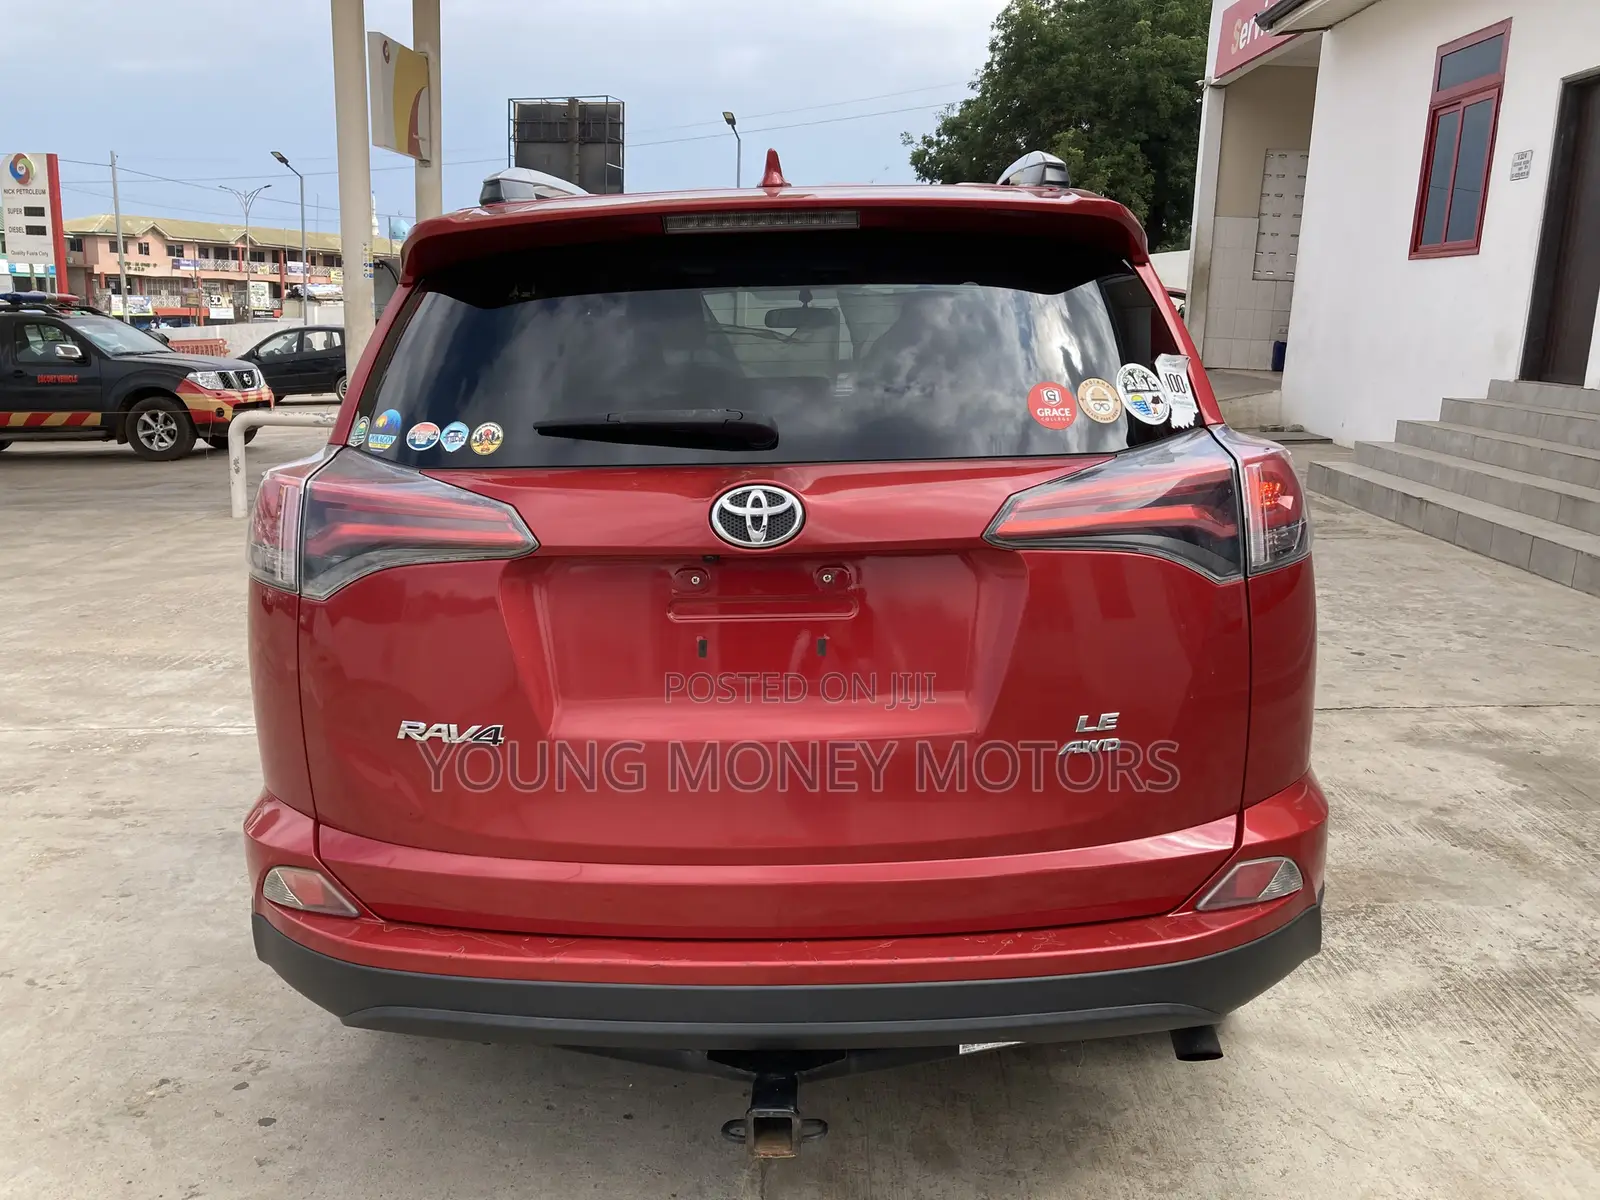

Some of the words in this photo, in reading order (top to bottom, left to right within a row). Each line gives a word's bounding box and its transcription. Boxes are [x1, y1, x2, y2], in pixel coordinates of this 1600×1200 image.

[1164, 372, 1187, 394] 100
[1036, 407, 1072, 417] GRACE
[397, 720, 506, 746] RAV4
[1076, 711, 1121, 734] LE
[1058, 738, 1122, 756] AWD
